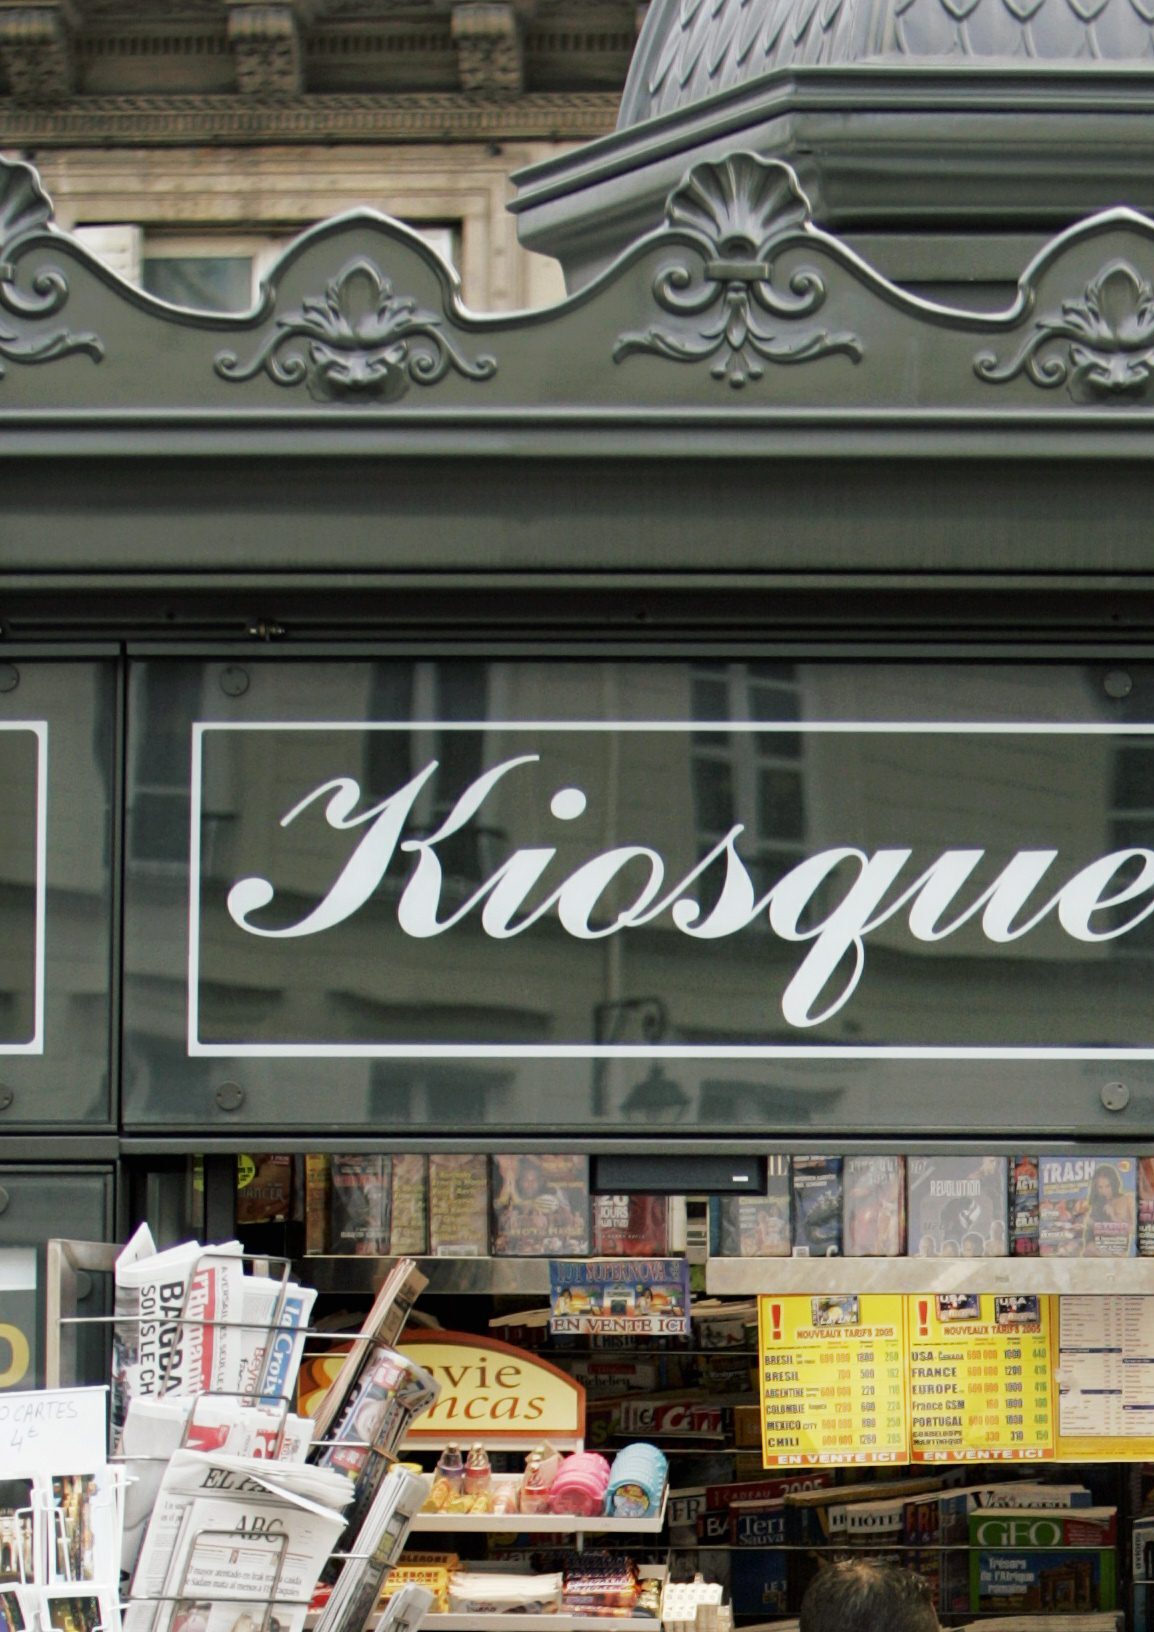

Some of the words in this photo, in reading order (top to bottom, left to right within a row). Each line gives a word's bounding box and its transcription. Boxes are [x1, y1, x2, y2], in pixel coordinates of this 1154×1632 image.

[1042, 1161, 1096, 1184] TRASH
[553, 1318, 580, 1332] EN
[586, 1318, 652, 1332] VENTE
[658, 1318, 686, 1332] ICI
[944, 1325, 988, 1336] NOUVEAUX
[797, 1329, 842, 1340] NOUVEAUX
[845, 1328, 873, 1338] TARIFS
[765, 1355, 793, 1366] BRESIL
[912, 1351, 934, 1361] USA
[264, 1333, 293, 1396] Croix
[765, 1371, 799, 1382] BRESIL
[911, 1367, 957, 1378] FRANCE
[912, 1384, 958, 1394] EUROPE
[13, 1401, 78, 1422] CARTES
[766, 1404, 805, 1415] COLOMBIE
[912, 1401, 943, 1411] France
[767, 1420, 801, 1431] MEXICO
[912, 1416, 962, 1427] PORTUGAL
[768, 1437, 800, 1448] CHILI
[777, 1455, 802, 1464] EN
[808, 1453, 866, 1464] VENTE
[872, 1452, 897, 1462] ICI
[923, 1451, 948, 1460] EN
[954, 1450, 1013, 1460] VENTE
[1019, 1449, 1043, 1459] ICI
[200, 1467, 235, 1490] EL
[230, 1515, 285, 1543] ABC
[977, 1520, 1062, 1546] GEO
